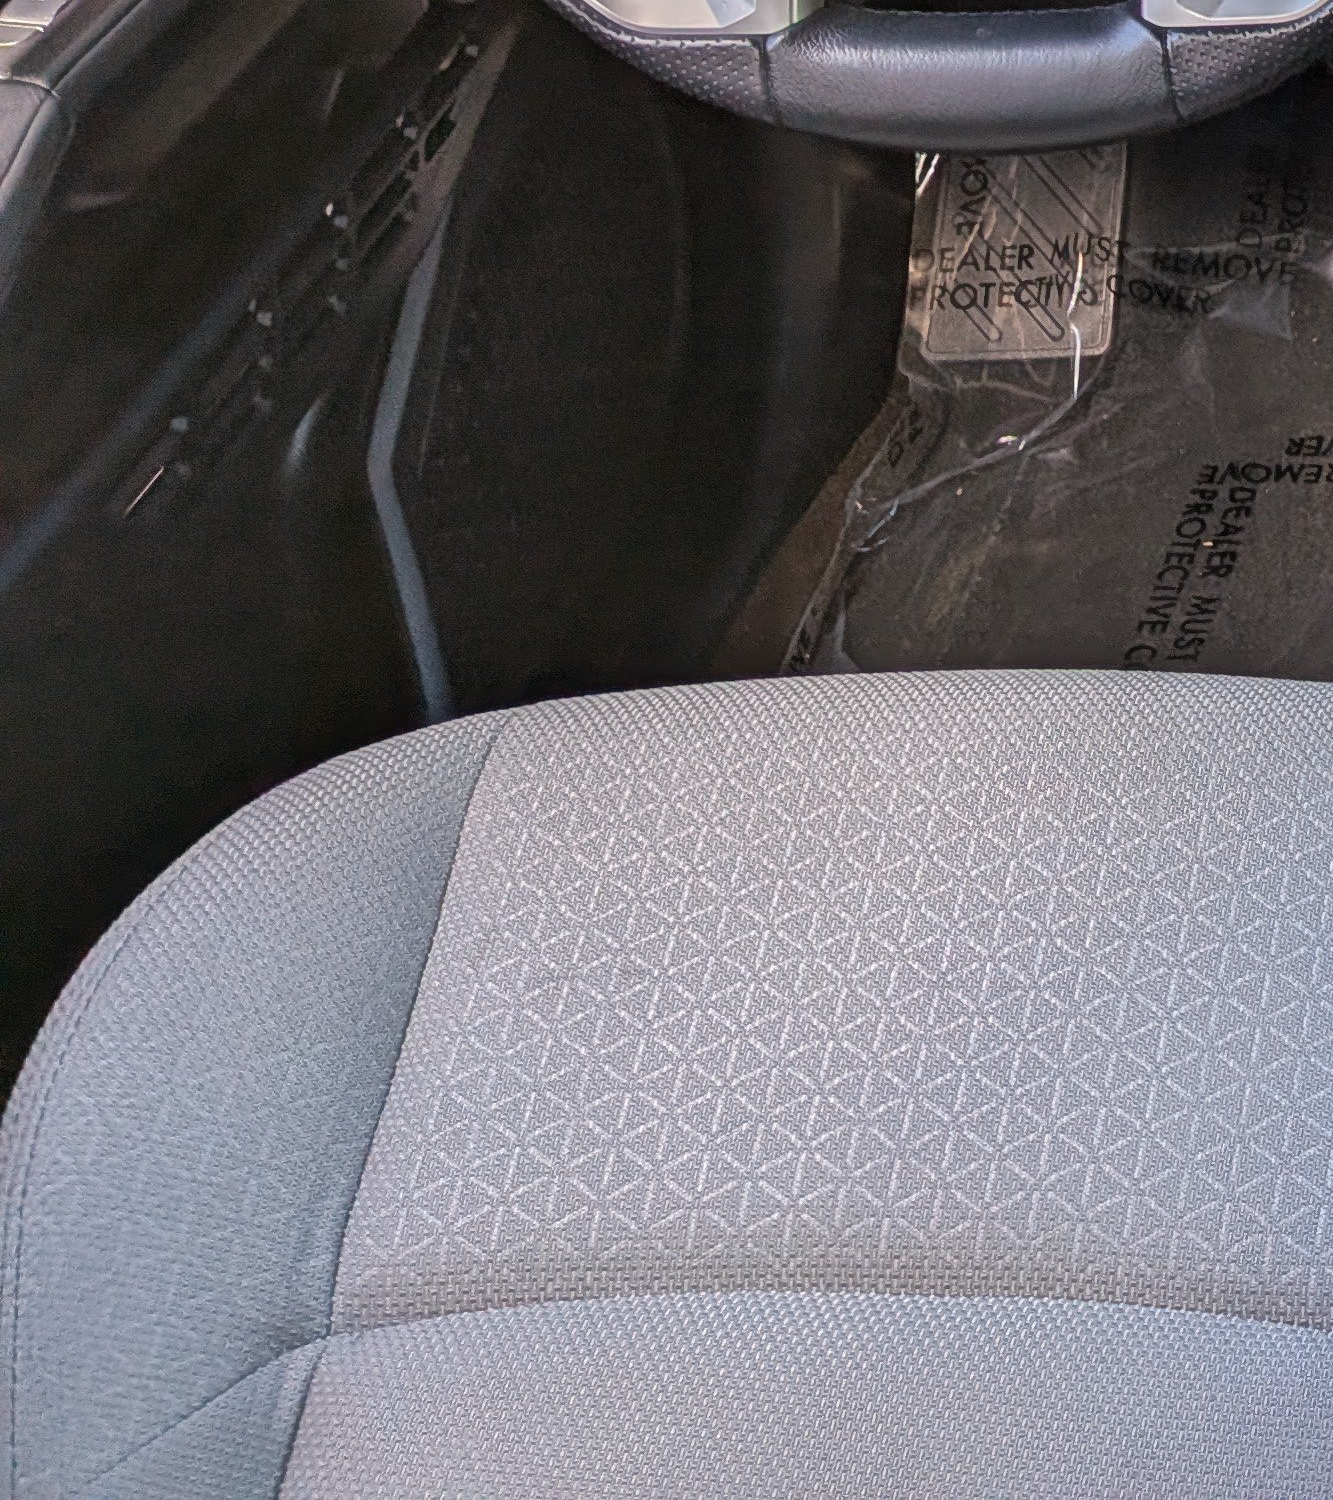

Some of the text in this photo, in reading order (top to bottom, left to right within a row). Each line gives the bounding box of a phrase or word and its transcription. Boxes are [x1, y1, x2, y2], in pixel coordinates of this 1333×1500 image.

[1136, 488, 1219, 634] PROTECTIVE
[1167, 486, 1257, 664] DEALER MUST
